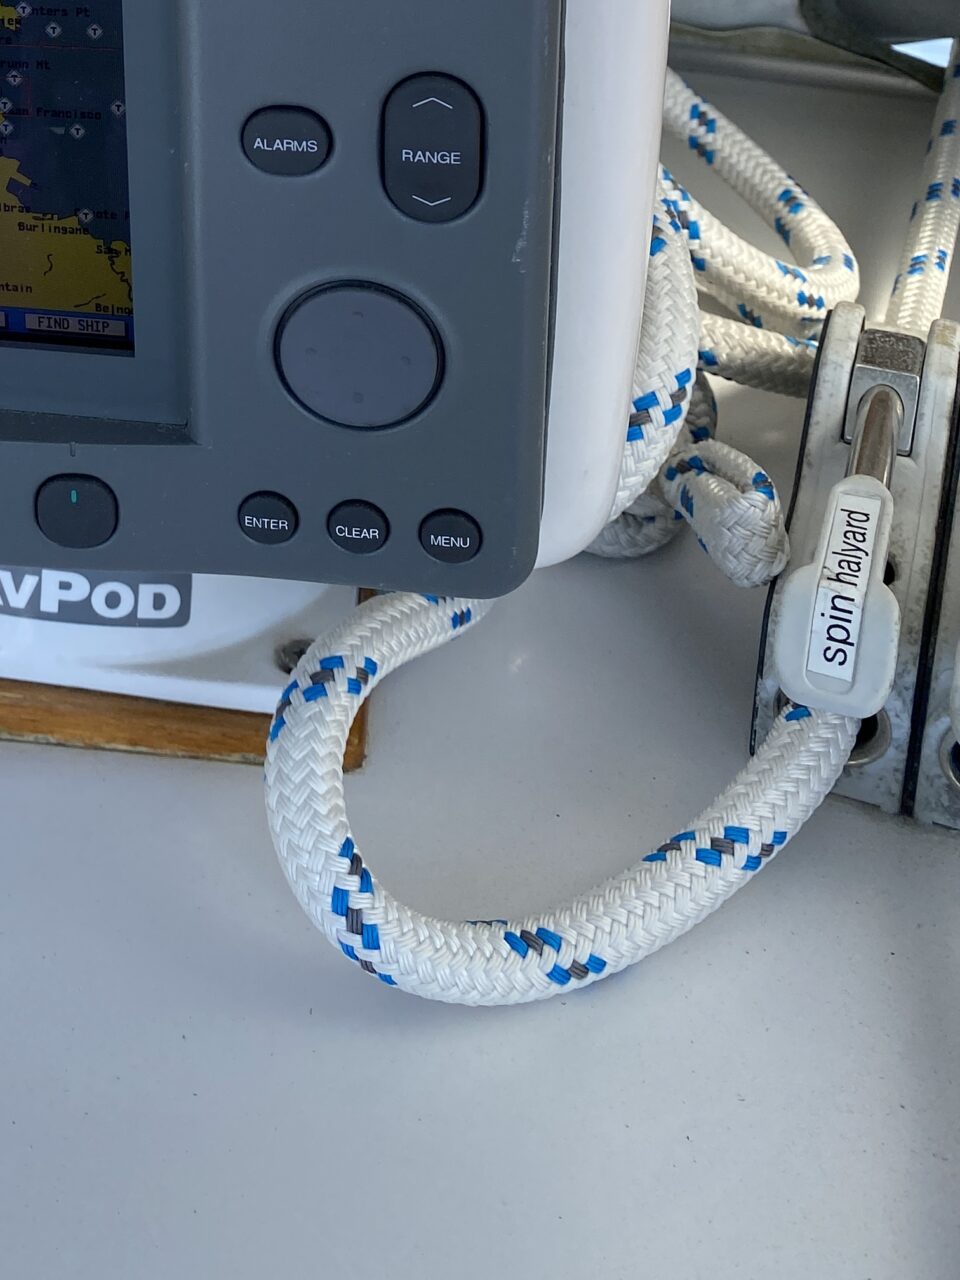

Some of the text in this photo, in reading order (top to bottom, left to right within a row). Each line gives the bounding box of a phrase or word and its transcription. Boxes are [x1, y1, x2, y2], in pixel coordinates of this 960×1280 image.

[35, 107, 102, 120] Francisco
[253, 137, 318, 152] ALARMS
[401, 149, 461, 165] RANGE
[37, 316, 110, 333] FIND SHIP
[244, 516, 289, 531] ENTER
[335, 525, 379, 539] CLEAR
[430, 534, 470, 548] MENU
[820, 508, 871, 667] spin halyard
